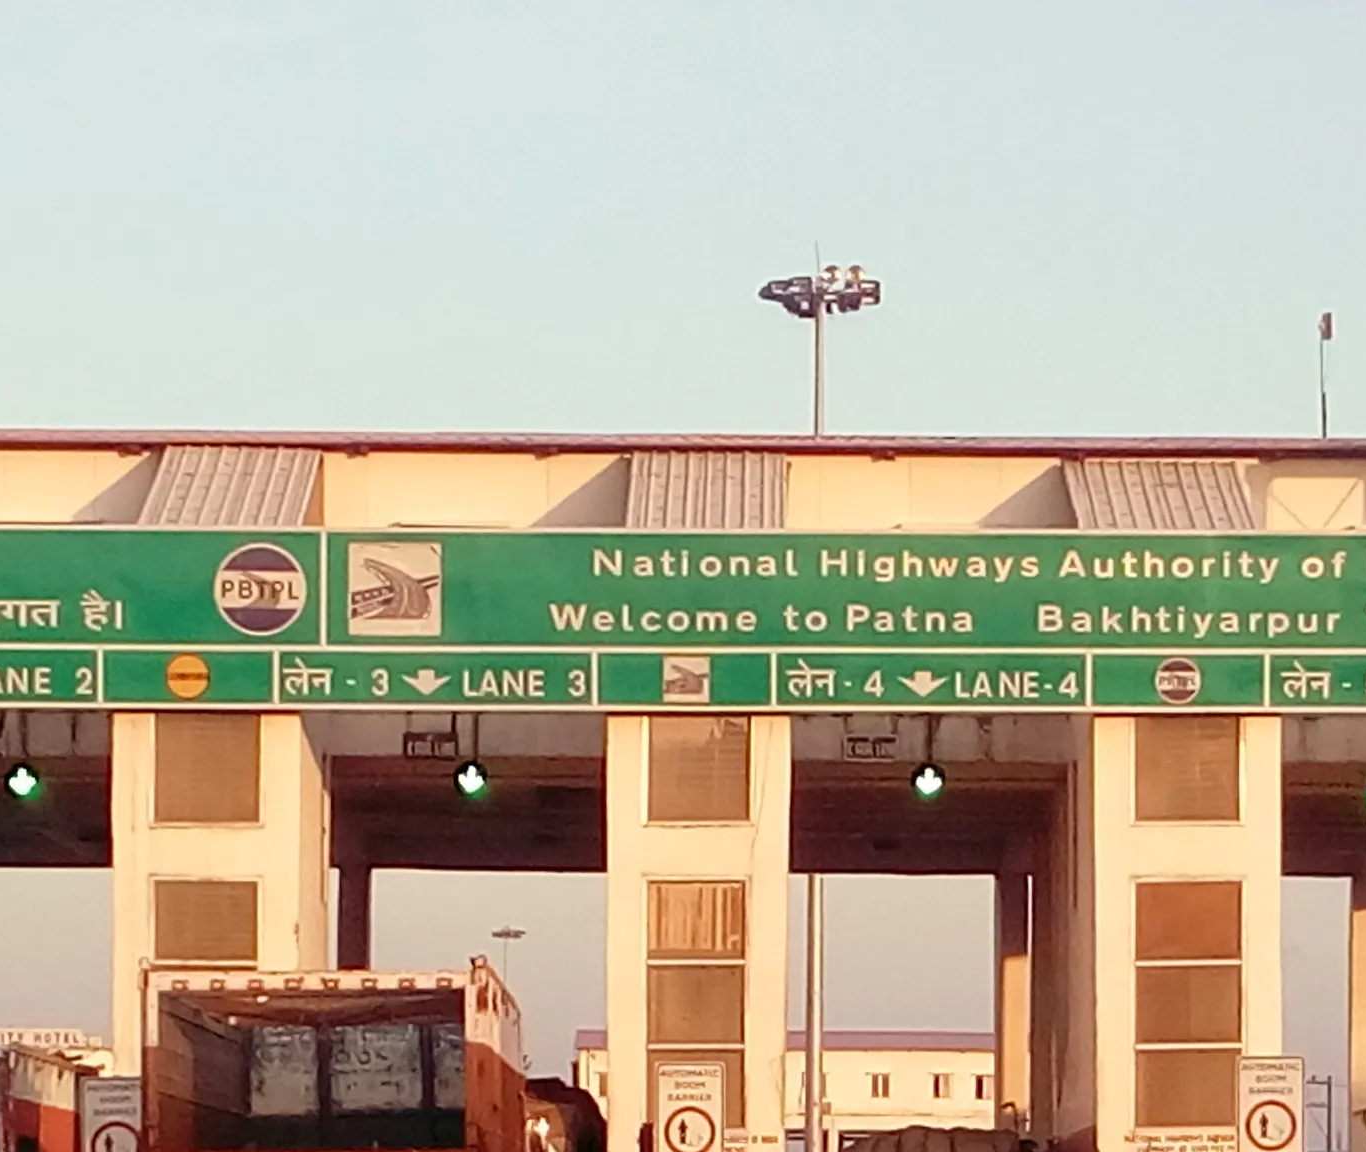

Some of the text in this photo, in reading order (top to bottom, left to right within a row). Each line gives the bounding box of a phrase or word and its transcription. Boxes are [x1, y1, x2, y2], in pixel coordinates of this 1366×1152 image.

[593, 549, 799, 578] National
[821, 550, 1040, 583] Highways
[1059, 549, 1280, 584] Authority
[1301, 550, 1347, 579] of
[221, 580, 300, 600] PBTPL
[549, 603, 757, 632] Welcome
[783, 604, 828, 632] to
[847, 604, 973, 632] Patna
[1038, 604, 1341, 639] Bakhtiyarpur
[75, 667, 94, 695] 2
[283, 661, 333, 697] लेन
[462, 669, 587, 698] LANE 3
[785, 661, 837, 699] लेन
[1281, 663, 1332, 700] लेन
[34, 1032, 81, 1046] HOTEL
